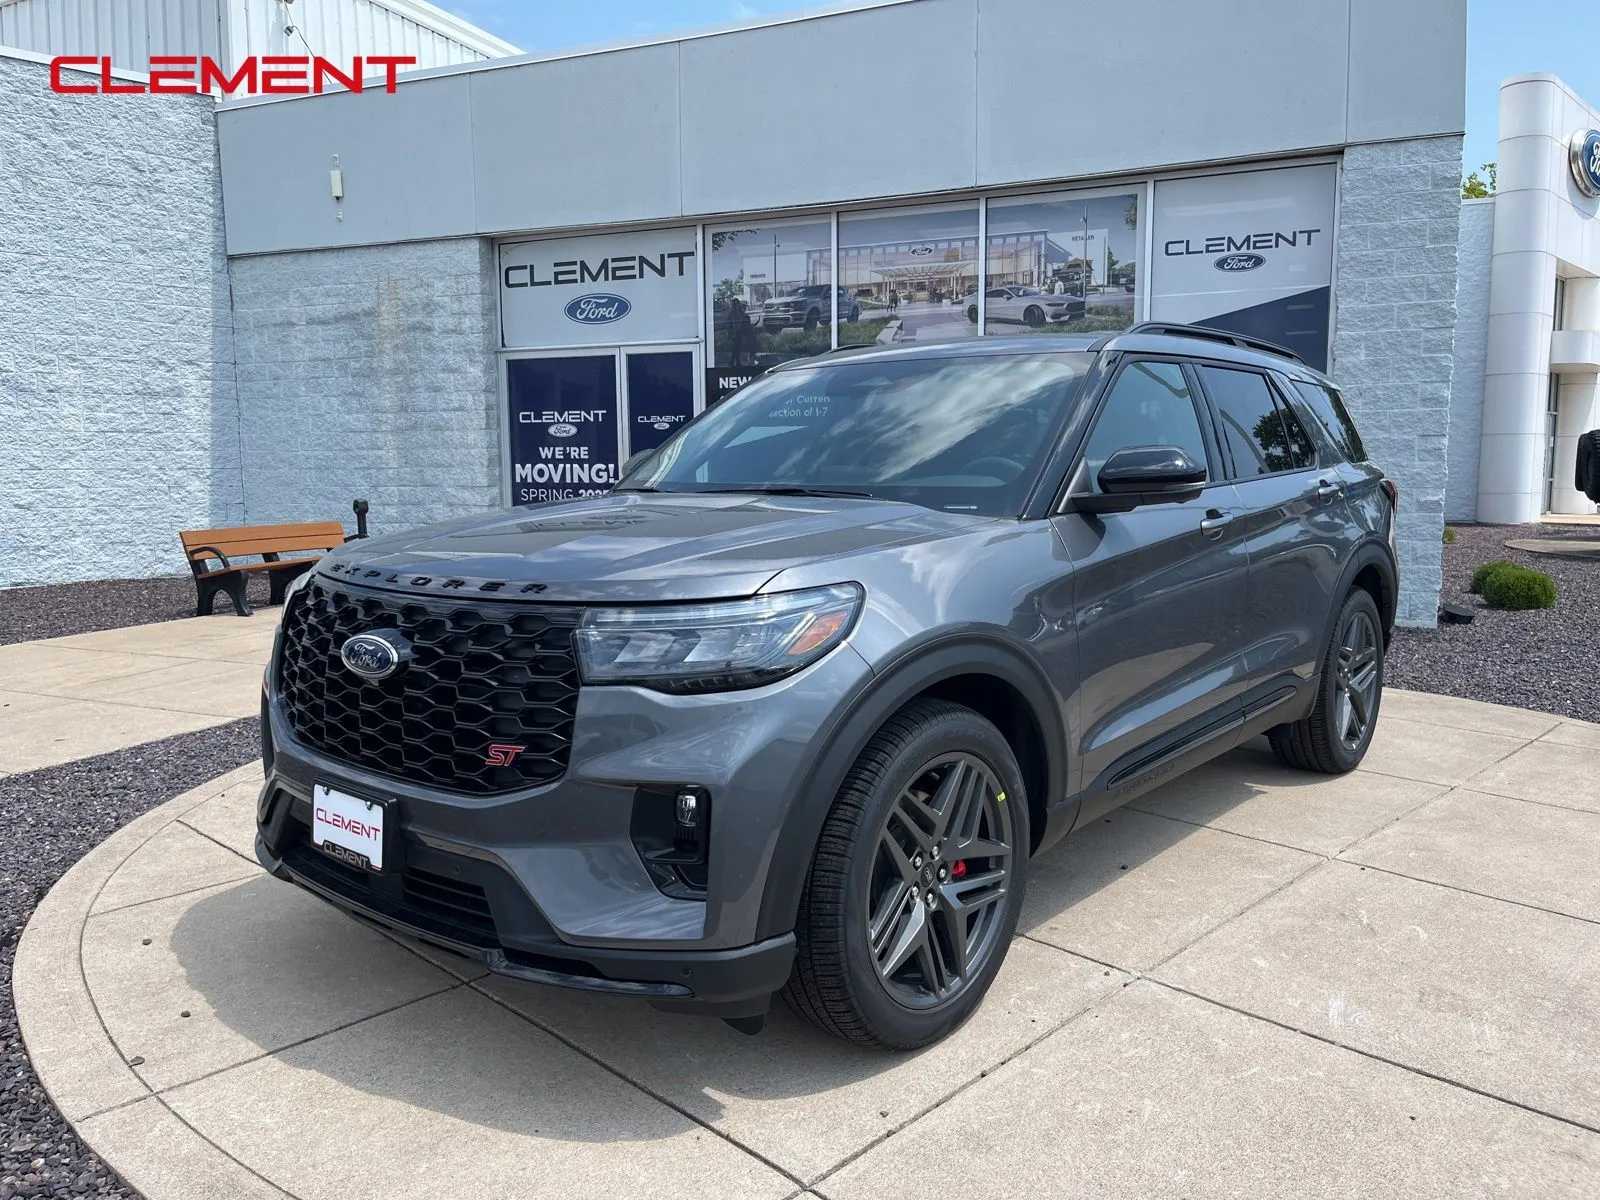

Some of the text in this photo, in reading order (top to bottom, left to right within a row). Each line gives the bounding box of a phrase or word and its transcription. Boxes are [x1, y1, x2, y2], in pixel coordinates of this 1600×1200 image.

[1164, 228, 1321, 257] CLEMENT
[504, 251, 695, 289] CLEMENT
[1223, 256, 1256, 270] Ford
[576, 298, 619, 320] Ford
[519, 410, 607, 423] CLEMENT
[637, 415, 686, 423] CLEMENT
[539, 446, 589, 460] WE'RE
[515, 463, 615, 484] MOVING!
[521, 488, 573, 501] SPRING
[330, 563, 548, 594] EXPLORER
[350, 642, 382, 669] Ford
[485, 744, 526, 766] ST
[316, 807, 381, 841] CLEMENT
[323, 841, 369, 869] CLEMENT
